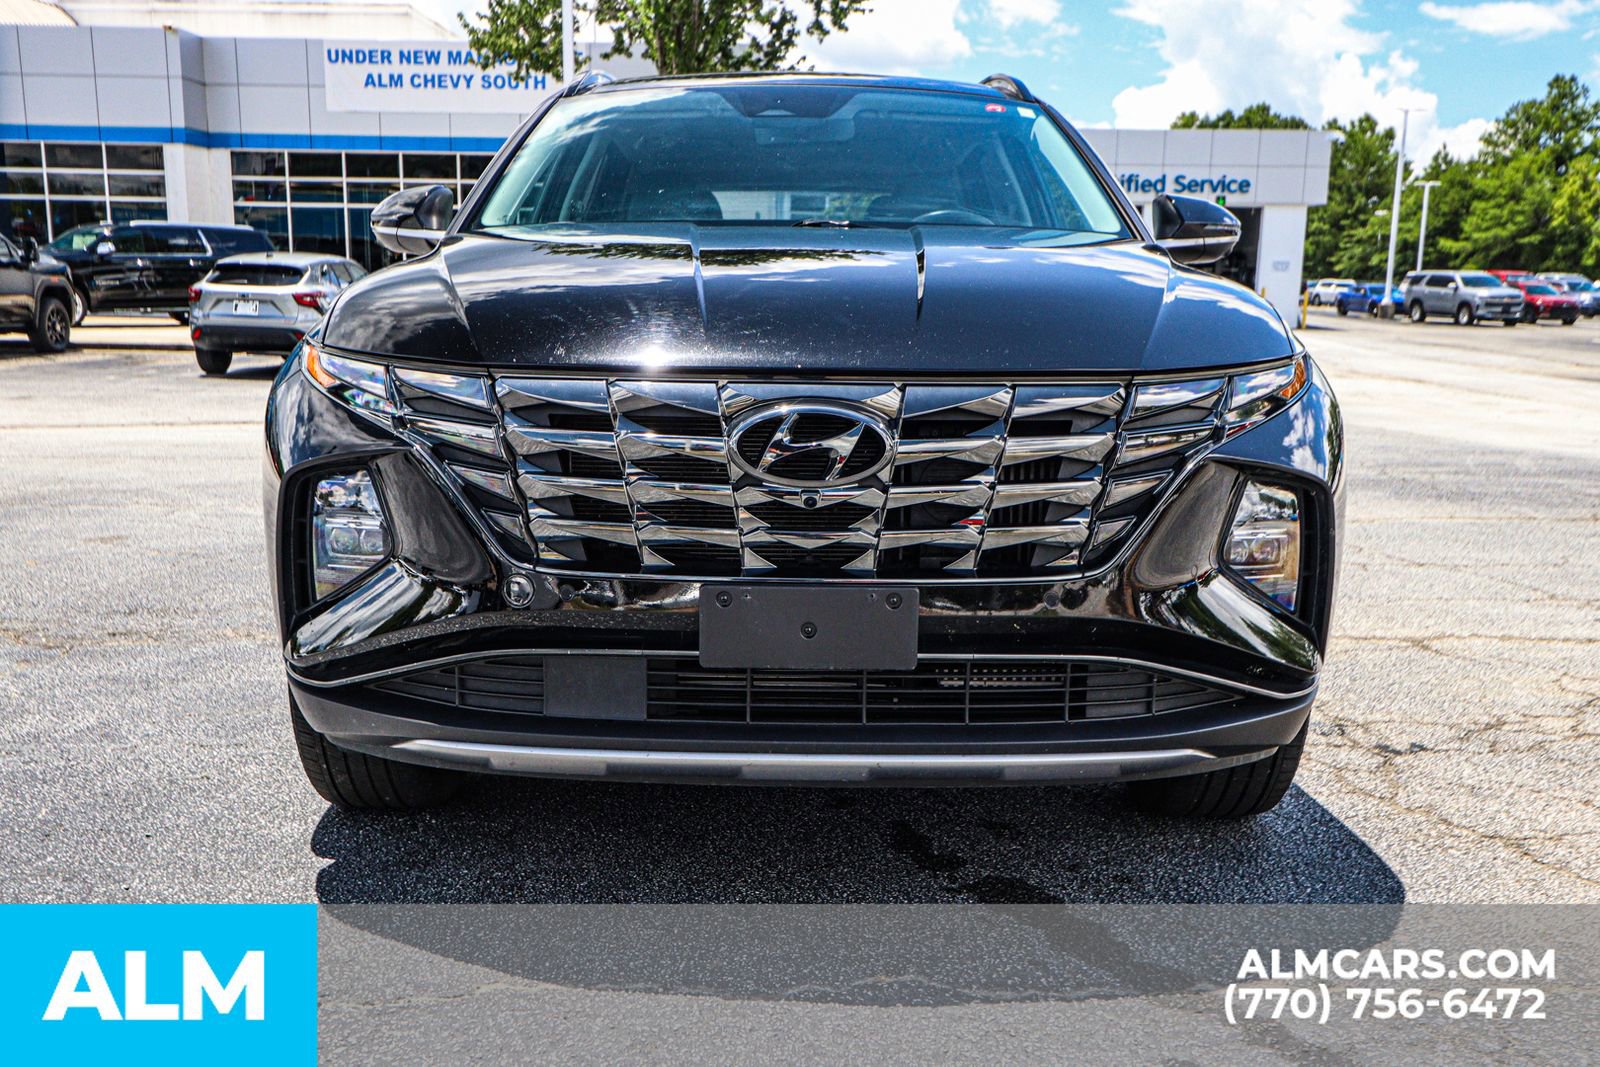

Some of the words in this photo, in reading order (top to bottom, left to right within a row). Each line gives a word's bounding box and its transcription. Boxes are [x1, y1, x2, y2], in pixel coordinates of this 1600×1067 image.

[327, 48, 393, 65] UNDER
[399, 49, 442, 66] NEW
[364, 73, 404, 89] ALM
[410, 73, 475, 90] CHEVY
[1173, 174, 1252, 194] Service
